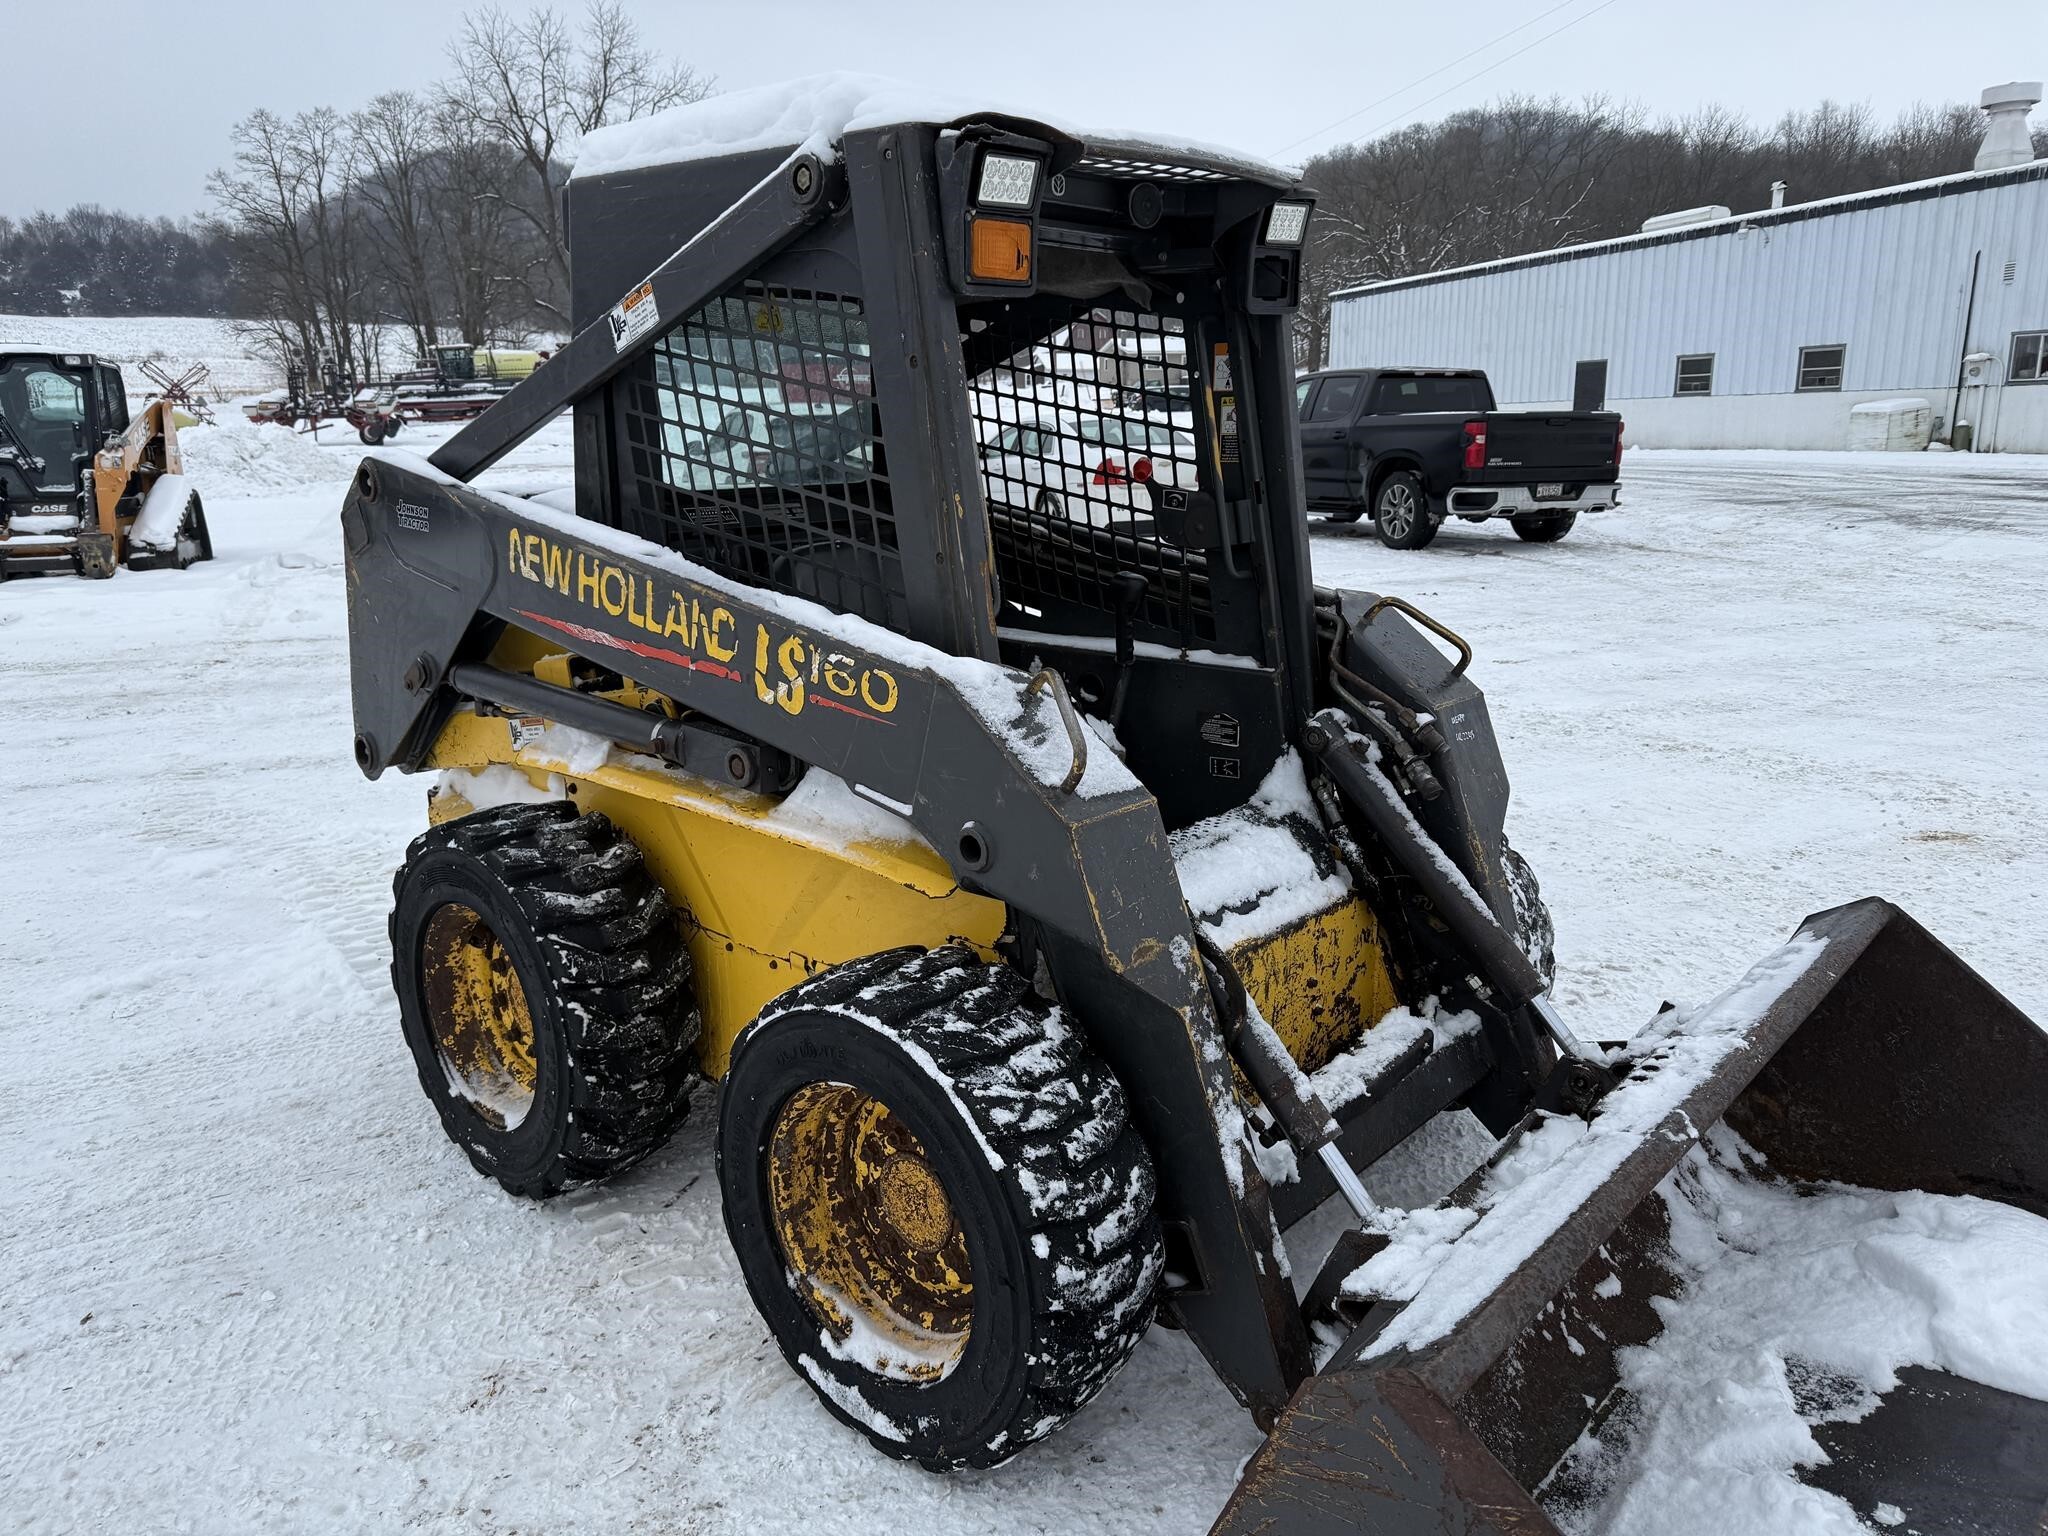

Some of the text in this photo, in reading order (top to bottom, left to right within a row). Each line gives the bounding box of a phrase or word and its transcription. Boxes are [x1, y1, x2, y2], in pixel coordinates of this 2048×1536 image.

[31, 504, 69, 513] CASE
[396, 499, 429, 518] JOHNSON
[398, 513, 430, 532] TRACTOR
[509, 527, 574, 597] NEW
